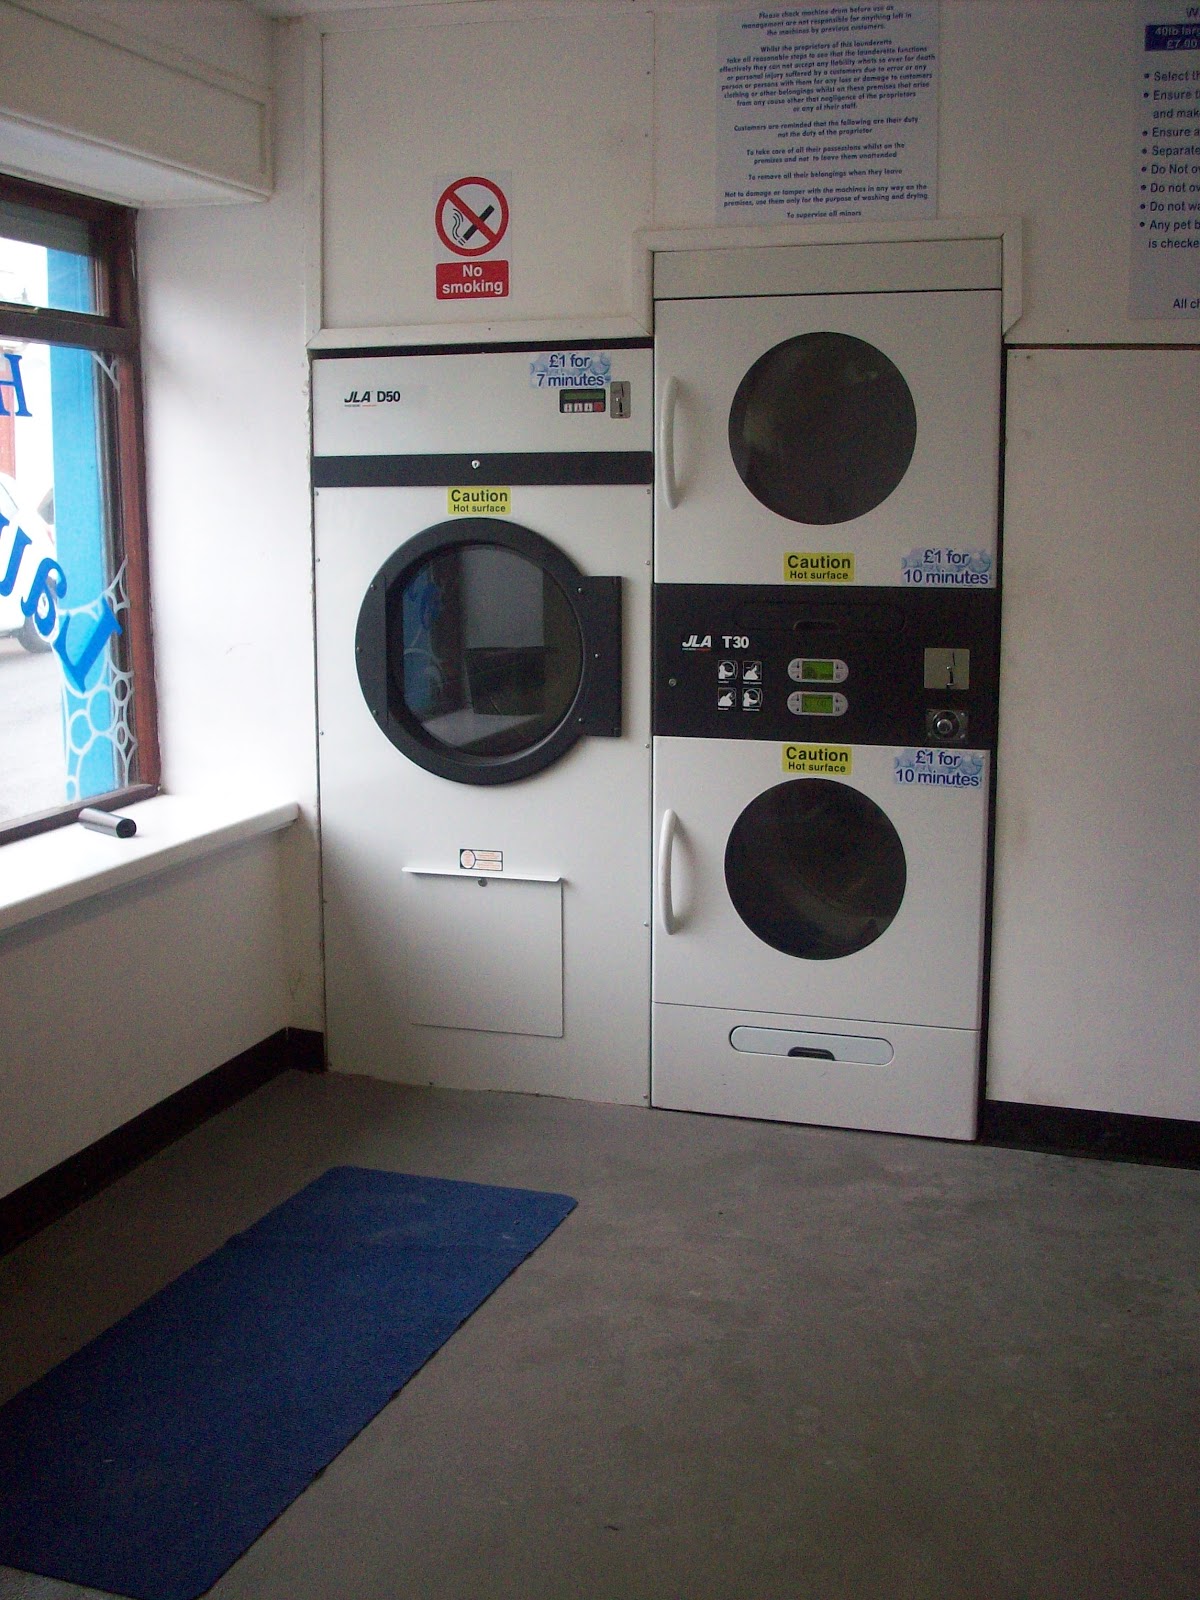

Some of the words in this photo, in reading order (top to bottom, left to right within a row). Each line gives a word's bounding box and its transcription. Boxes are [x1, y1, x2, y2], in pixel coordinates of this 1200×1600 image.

[1154, 71, 1189, 81] Select
[1153, 90, 1191, 100] Ensure
[1153, 109, 1173, 118] and
[1177, 108, 1200, 118] mak
[1152, 127, 1191, 137] Ensure
[1151, 164, 1166, 174] Do
[1169, 164, 1188, 174] Not
[1150, 182, 1165, 193] Do
[1168, 183, 1186, 192] not
[1150, 201, 1164, 211] Do
[1168, 202, 1185, 211] not
[1150, 220, 1170, 232] Any
[1174, 220, 1191, 232] pet
[1148, 239, 1157, 248] is
[463, 264, 482, 277] No
[442, 280, 503, 295] smoking
[1173, 298, 1187, 309] All
[549, 354, 565, 368] £1
[570, 354, 590, 367] for
[536, 374, 545, 387] 7
[548, 373, 604, 386] minutes
[344, 391, 370, 403] JLA
[377, 391, 400, 402] D50
[451, 489, 508, 502] Caution
[454, 504, 469, 512] Hot
[472, 504, 506, 512] surface
[788, 555, 851, 569] Caution
[923, 550, 941, 564] £1
[947, 550, 969, 564] for
[790, 571, 807, 579] Hot
[810, 571, 848, 580] surface
[904, 569, 922, 583] 10
[926, 569, 988, 584] minutes
[682, 635, 711, 647] JLA
[722, 636, 749, 648] T30
[786, 746, 848, 762] Caution
[915, 750, 933, 764] £1
[938, 751, 960, 766] for
[788, 762, 805, 770] Hot
[808, 762, 846, 772] surface
[896, 769, 914, 782] 10
[918, 770, 979, 786] minutes
